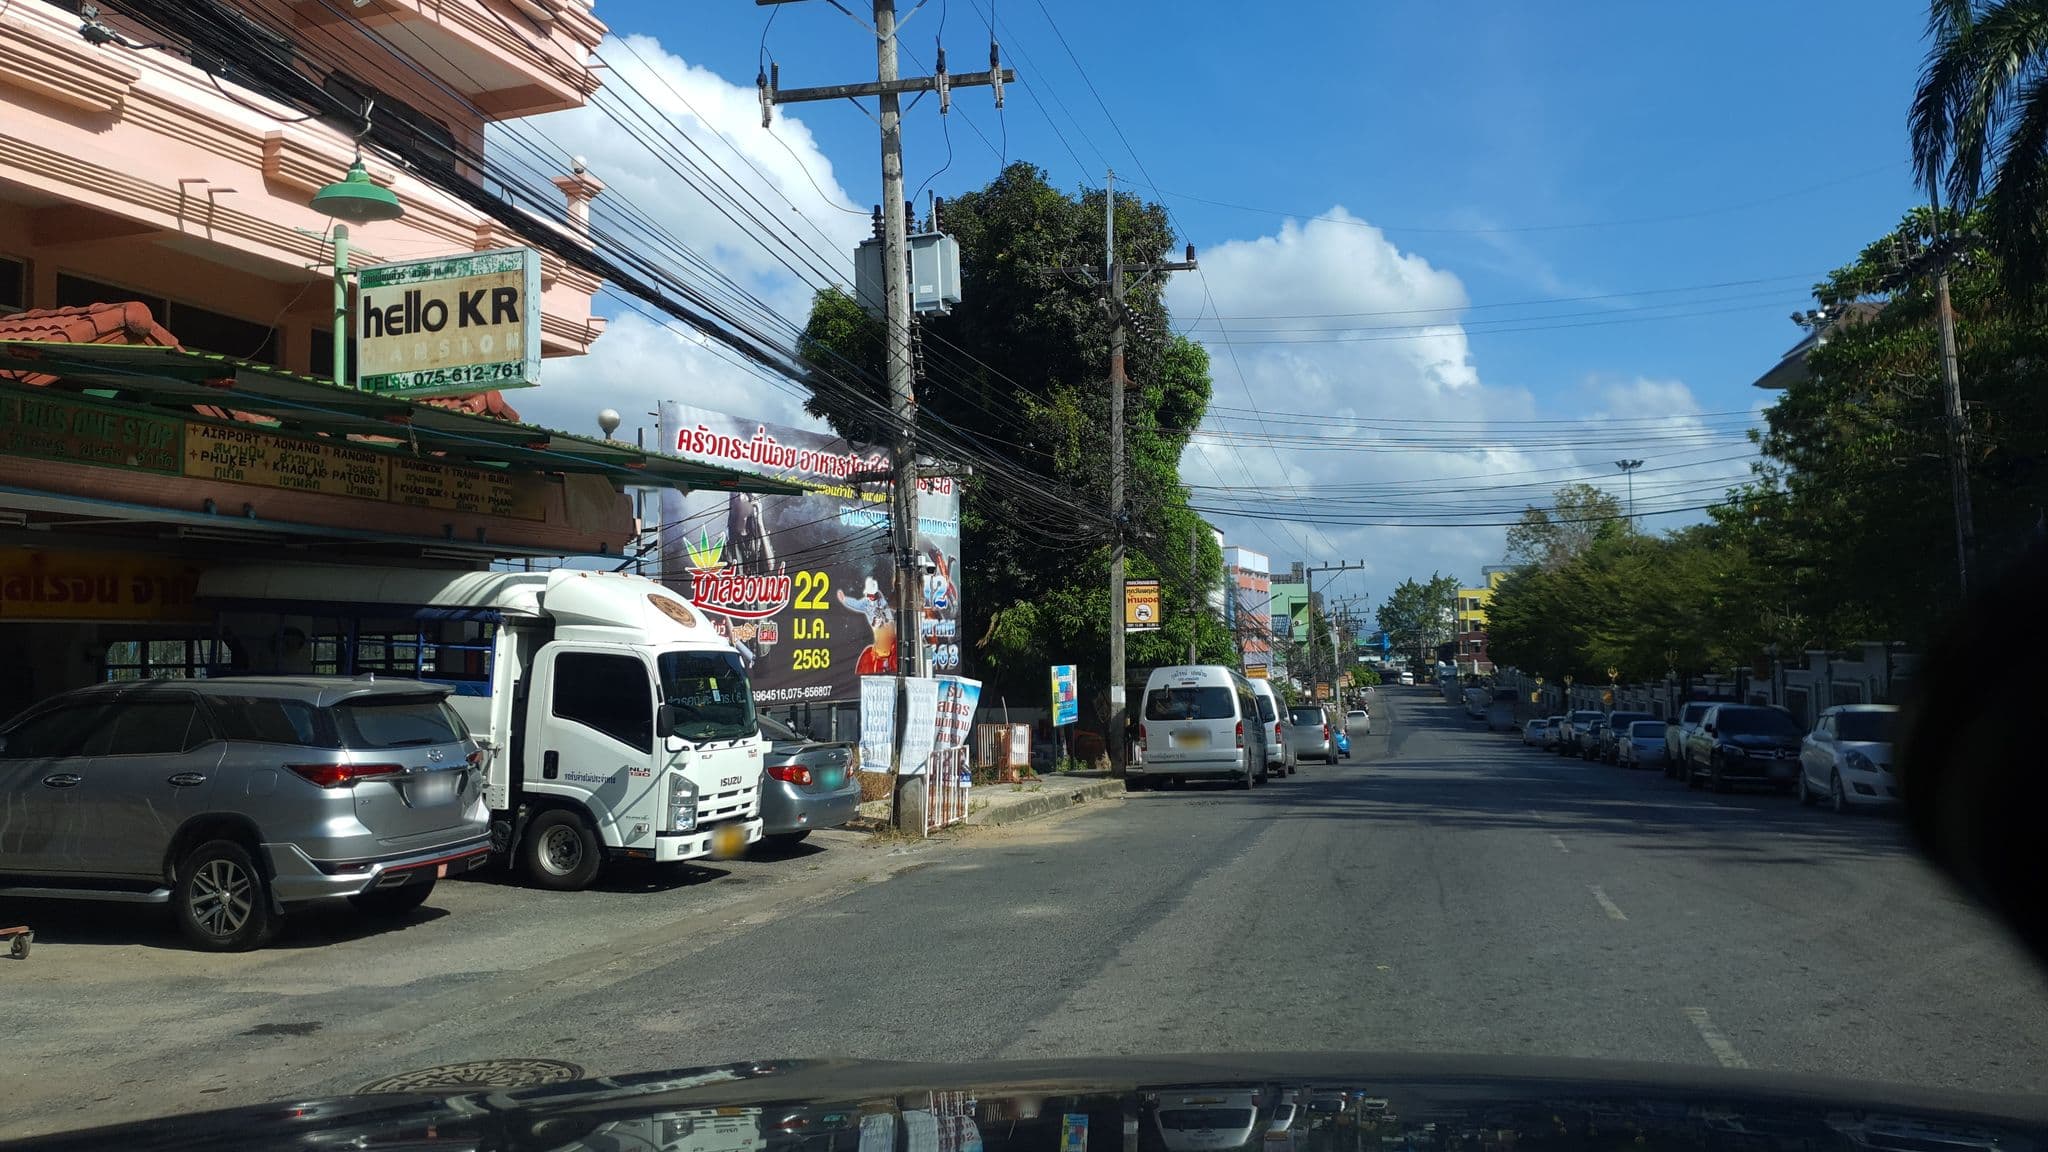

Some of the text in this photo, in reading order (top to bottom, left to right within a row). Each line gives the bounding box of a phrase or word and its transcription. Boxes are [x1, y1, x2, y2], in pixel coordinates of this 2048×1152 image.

[363, 285, 520, 339] hello KR
[413, 362, 523, 386] 075-612-761
[122, 420, 174, 448] STOP
[202, 427, 377, 464] AIRPORT AONANG RANONG
[677, 426, 796, 471] ครัวกระบี่น้อย
[200, 451, 258, 468] PHUKET
[332, 470, 376, 486] PATONG
[794, 570, 830, 610] 22
[793, 617, 830, 641] ม.ค.
[793, 648, 831, 674] 2563
[720, 776, 742, 787] ISUZU
